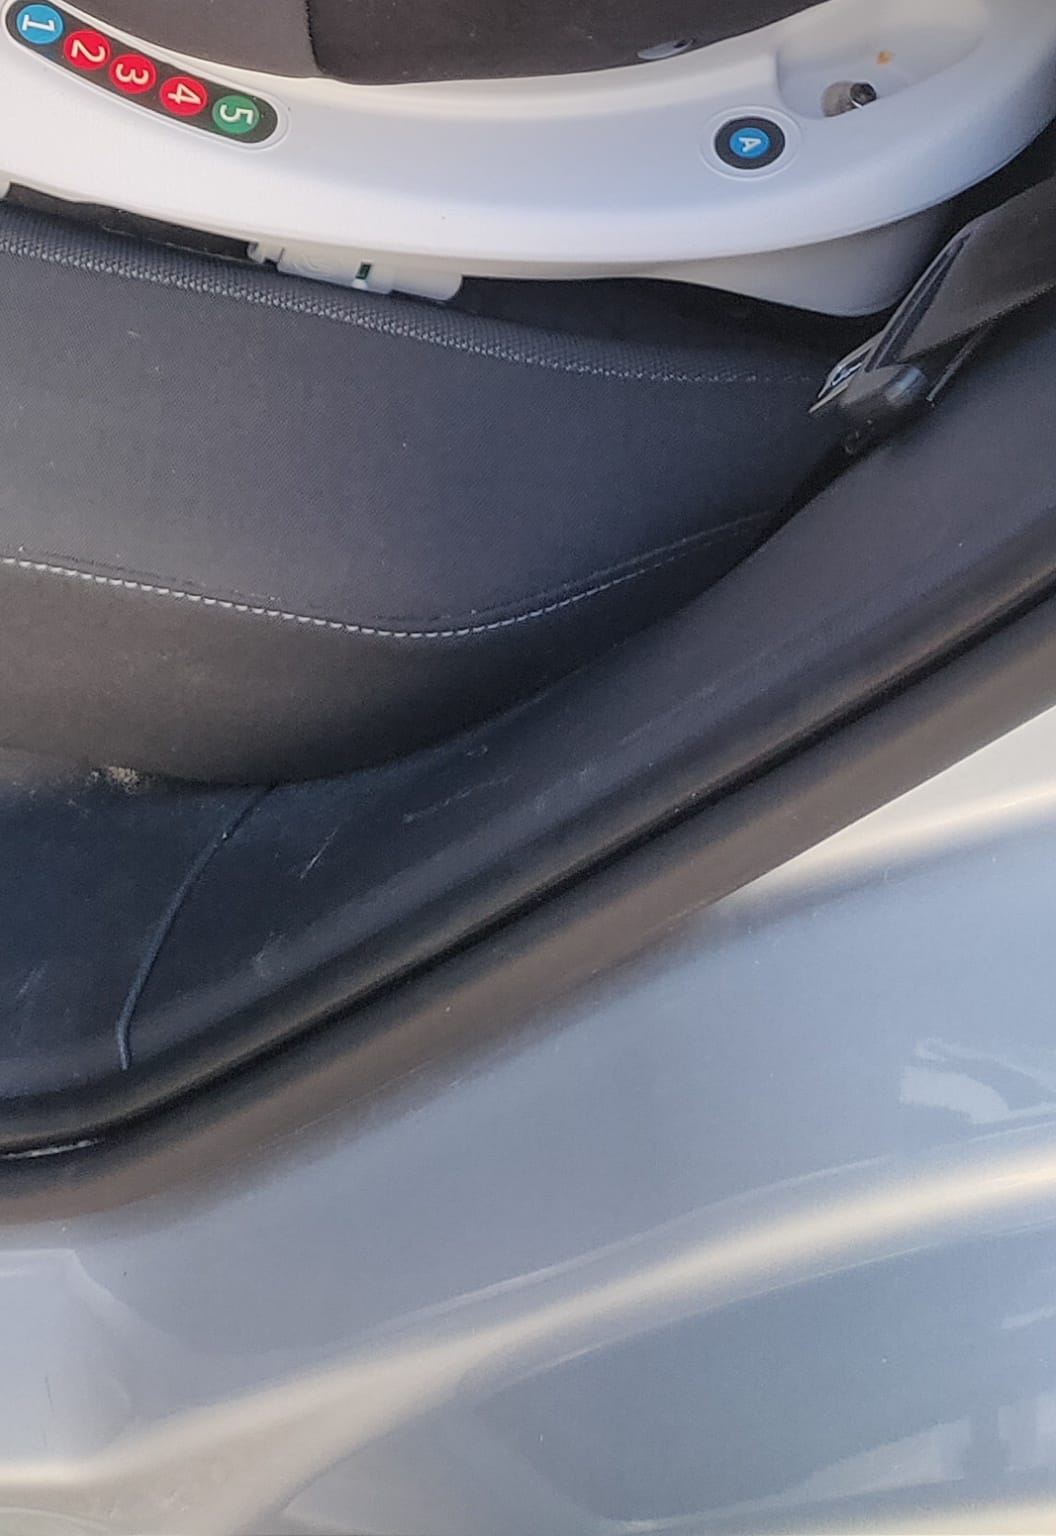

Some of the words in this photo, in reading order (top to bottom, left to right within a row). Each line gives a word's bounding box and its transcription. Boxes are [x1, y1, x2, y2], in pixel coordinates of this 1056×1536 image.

[21, 14, 55, 33] 1
[70, 39, 106, 63] 2
[115, 63, 149, 86] 3
[167, 82, 201, 106] 4
[219, 104, 254, 125] 5
[738, 136, 762, 153] A
